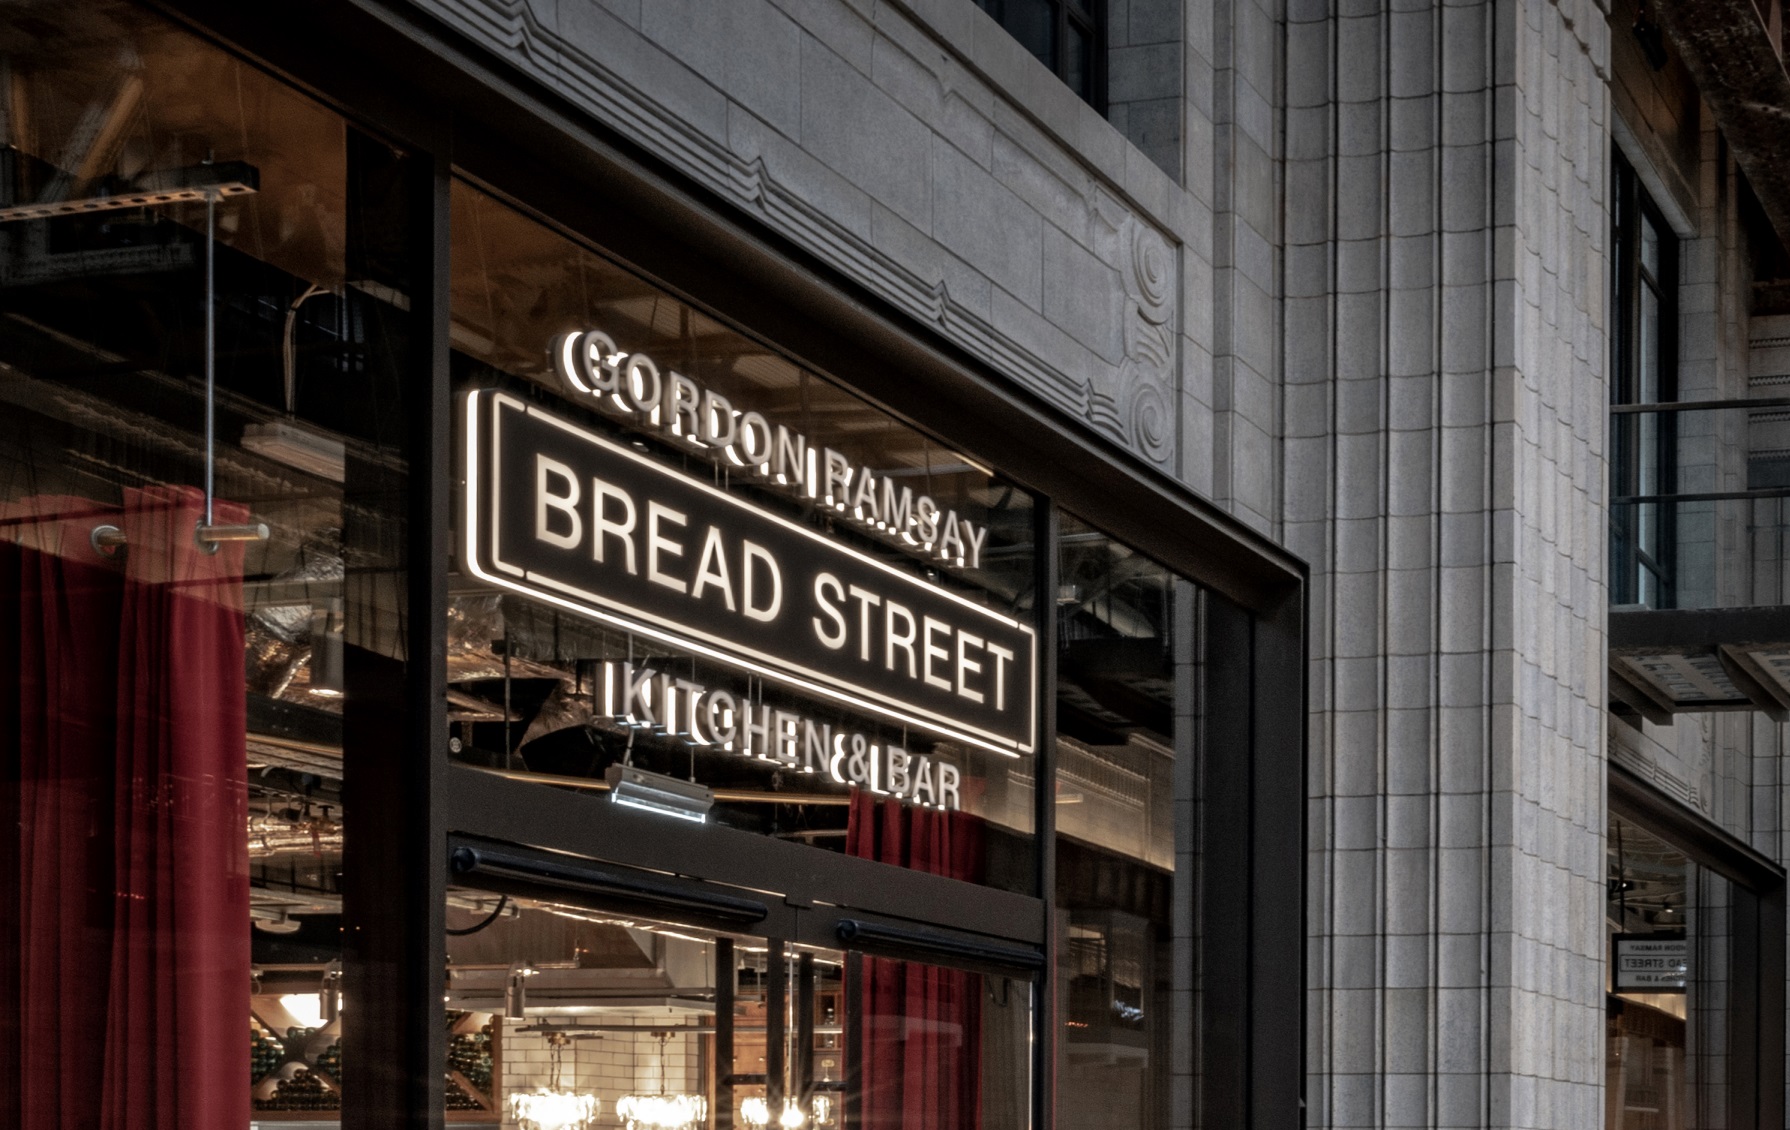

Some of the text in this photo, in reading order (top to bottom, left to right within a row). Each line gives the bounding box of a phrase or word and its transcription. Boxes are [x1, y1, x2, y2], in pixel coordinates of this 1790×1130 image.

[580, 330, 987, 569] GORDON RAMSAY
[534, 453, 1015, 711] BREAD STREET
[622, 661, 832, 774] KITCHEN
[886, 744, 961, 812] BAR
